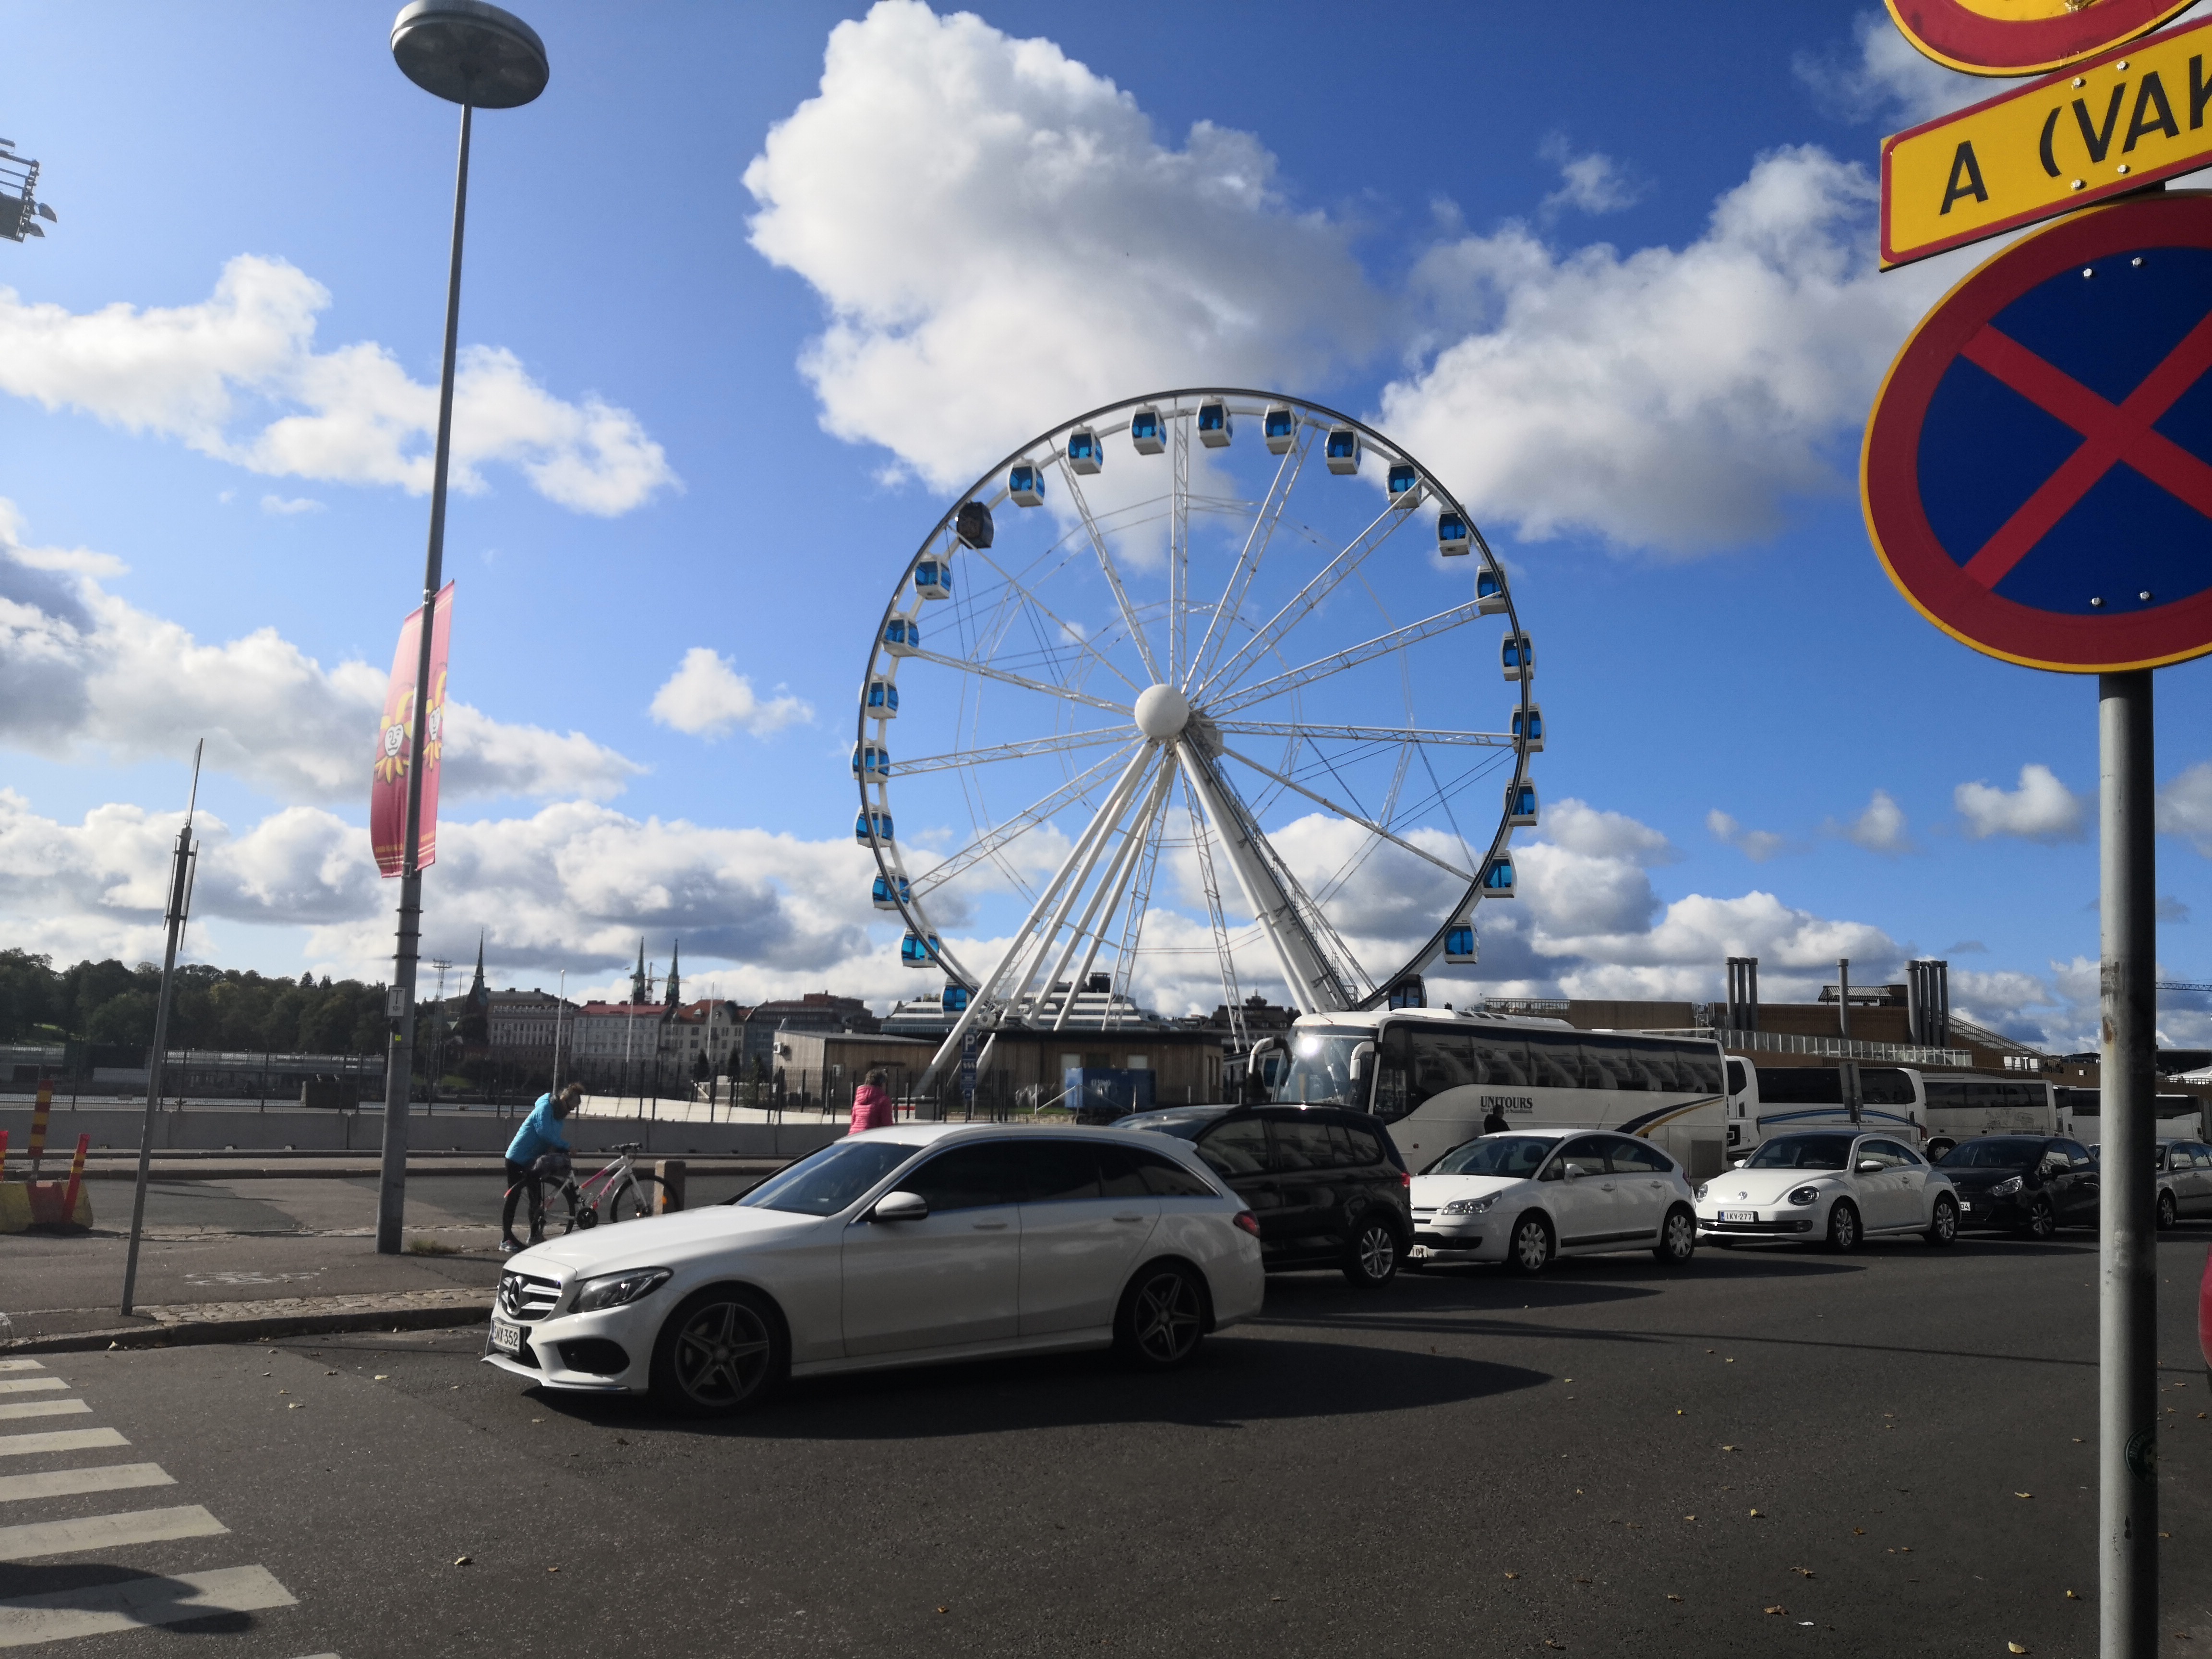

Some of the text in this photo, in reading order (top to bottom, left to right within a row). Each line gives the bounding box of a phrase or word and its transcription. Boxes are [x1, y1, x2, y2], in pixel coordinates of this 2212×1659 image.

[1940, 140, 1989, 215] A
[964, 1034, 975, 1051] P
[1480, 1095, 1533, 1108] UNITOURS
